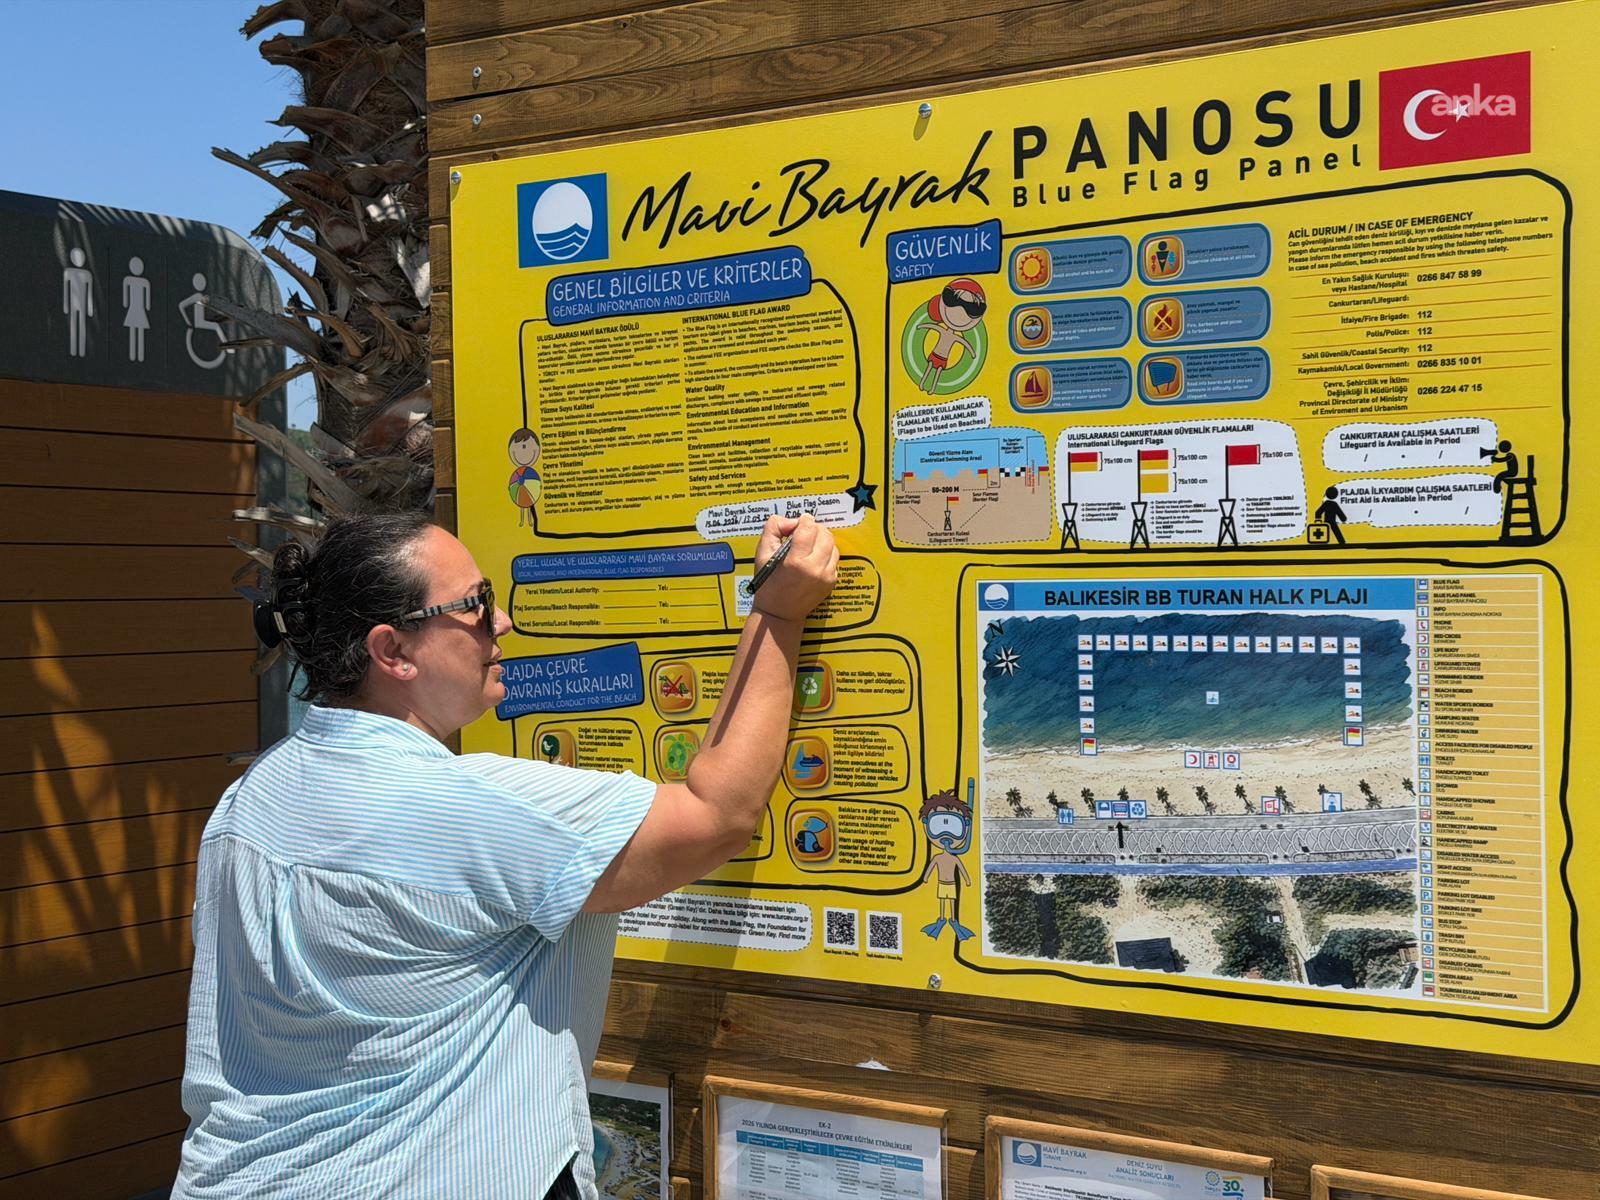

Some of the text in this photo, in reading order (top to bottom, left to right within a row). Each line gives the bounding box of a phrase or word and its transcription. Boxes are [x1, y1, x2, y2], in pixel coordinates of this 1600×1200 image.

[1013, 78, 1361, 180] PANOSU
[1013, 144, 1361, 208] Blue Flag Panel
[622, 130, 993, 249] Mavi Bayrak
[1287, 227, 1310, 239] ACİL
[1311, 224, 1347, 237] DURUM
[1354, 222, 1365, 232] IN
[1367, 219, 1393, 231] CASE
[1395, 217, 1408, 228] OF
[1410, 211, 1473, 226] EMERGENCY
[895, 230, 991, 260] GÜVENLİK
[895, 263, 934, 278] SAFETY
[552, 257, 802, 301] GENEL BİLGİLER VE KRİTERLER
[552, 290, 730, 317] GENERAL INFORMATION AND CRITERIA
[681, 304, 790, 324] INTERNATIONAL BLUE FLAG AWARD
[1417, 310, 1432, 319] 112
[1417, 326, 1432, 335] 112
[1417, 343, 1432, 352] 112
[1416, 356, 1481, 368] 0266 835 10 01
[684, 384, 725, 394] Water Quality
[1417, 383, 1482, 395] 0266 224 47 15
[686, 401, 809, 419] Environmental Education and Information
[896, 416, 930, 427] FLAMALAR
[940, 410, 977, 421] ANLAMLARI
[1067, 424, 1254, 441] ULUSLARARASI CANKURTARAN GÜVENLİK FLAMALARI
[1339, 425, 1479, 440] CANKURTARAN ÇALIŞMA SAATLERİ
[687, 437, 771, 451] Environmental Management
[1067, 437, 1164, 448] International Lifeguard Flags
[1339, 440, 1377, 449] Lifeguard
[1386, 438, 1423, 447] Available
[1424, 437, 1432, 445] in
[1433, 436, 1460, 444] Period
[688, 472, 746, 482] Safety and Services
[1339, 481, 1492, 496] PLAJDA İLKYARDIM ÇALIŞMA SAATLERİ
[786, 498, 840, 510] Blue Flag Season
[1340, 496, 1358, 504] First
[1373, 495, 1380, 503] is
[1380, 494, 1416, 503] Available
[1417, 494, 1425, 502] in
[1426, 493, 1452, 501] Period
[1044, 588, 1367, 606] BALIKESİR BB TURAN HALK PLAJI
[987, 618, 1004, 638] N
[546, 657, 588, 678] ÇEVRE
[565, 673, 633, 694] KURALLARI
